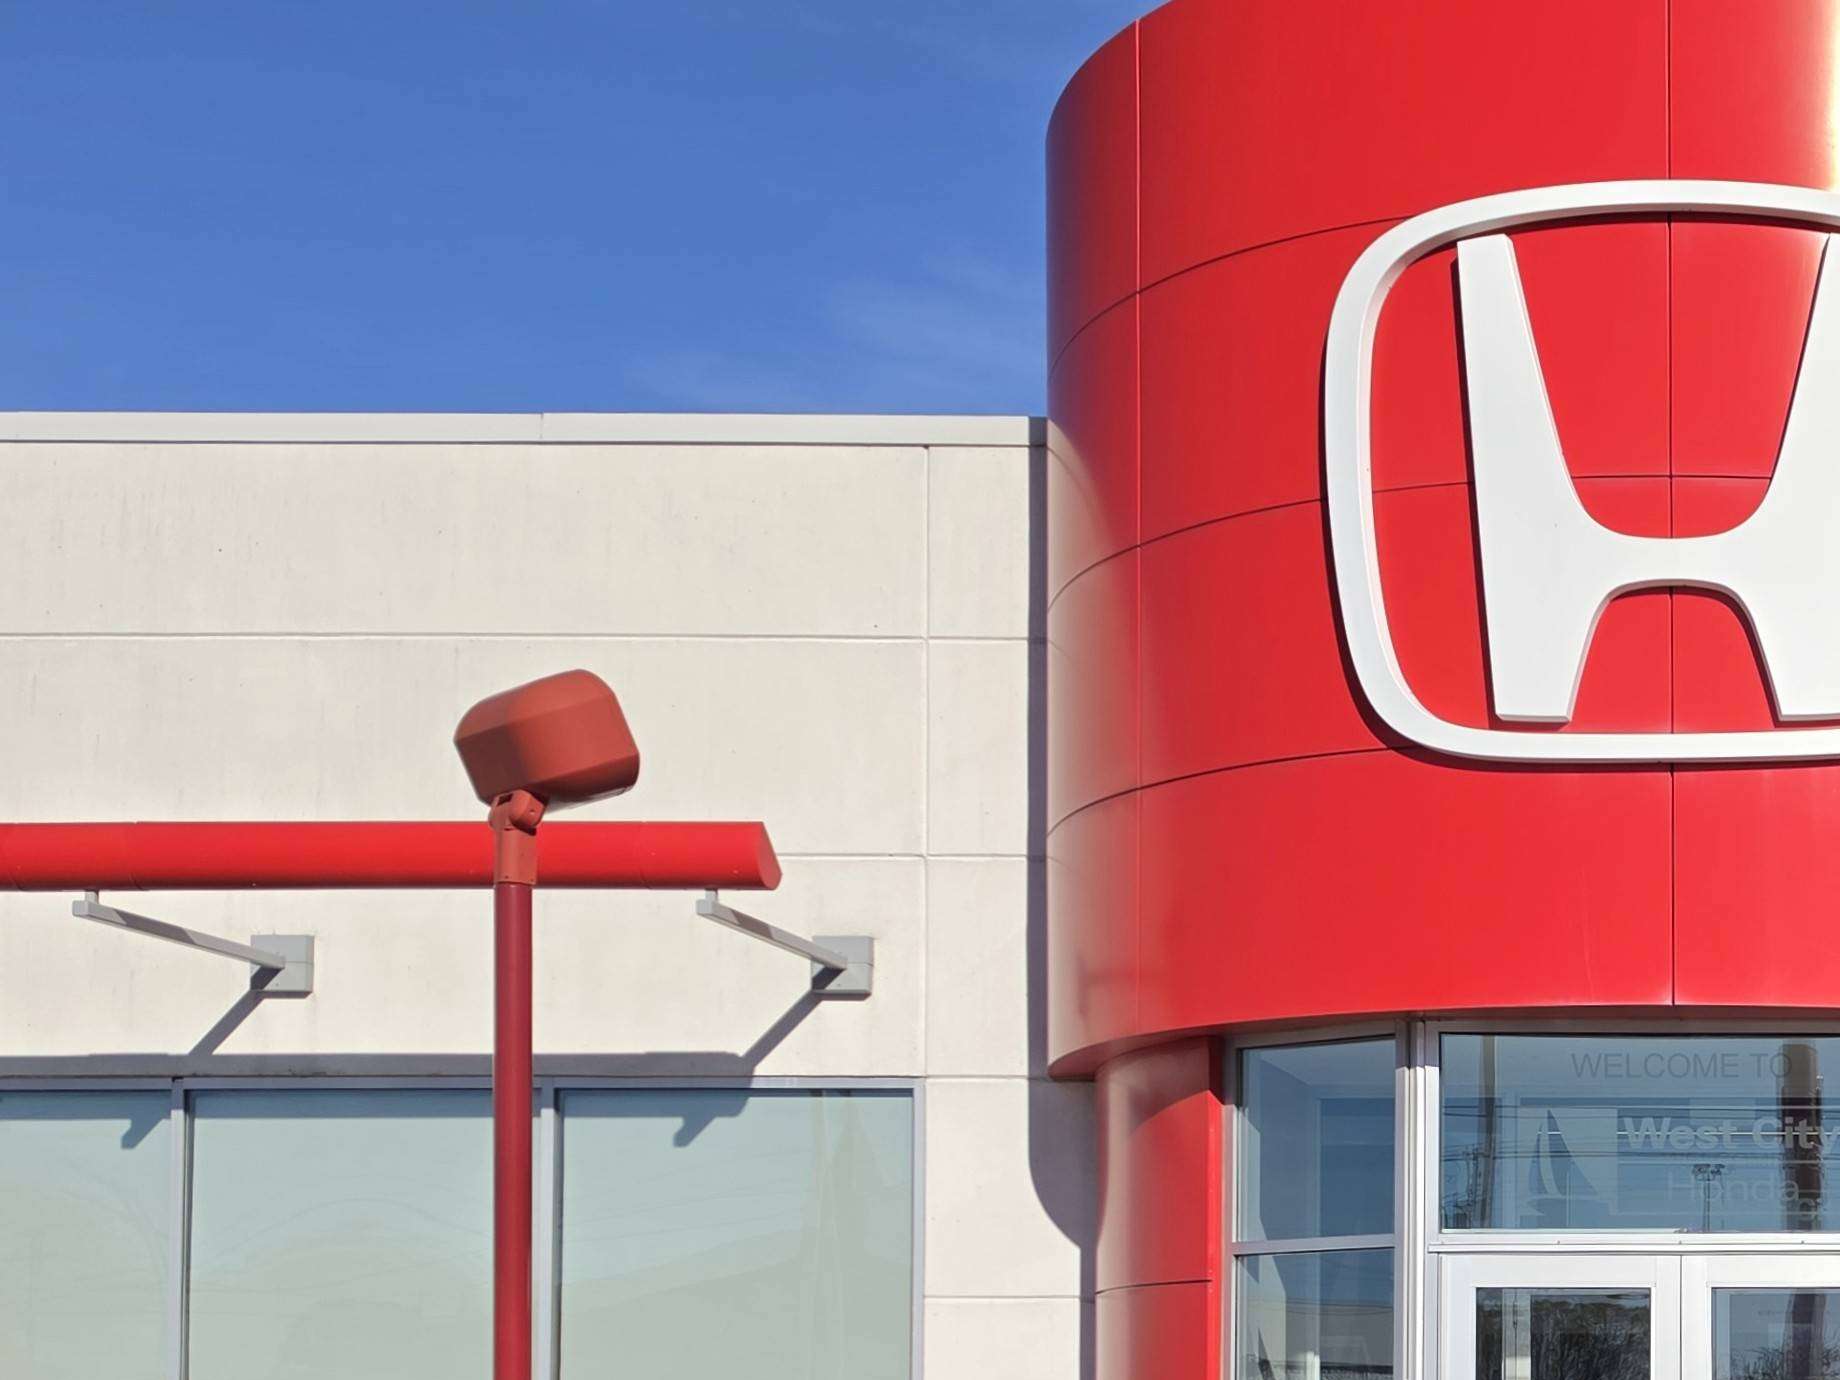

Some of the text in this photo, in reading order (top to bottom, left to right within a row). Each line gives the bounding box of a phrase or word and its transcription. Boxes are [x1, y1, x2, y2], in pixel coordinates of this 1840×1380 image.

[1571, 1052, 1793, 1079] WELCOME TO
[1623, 1116, 1738, 1150] West
